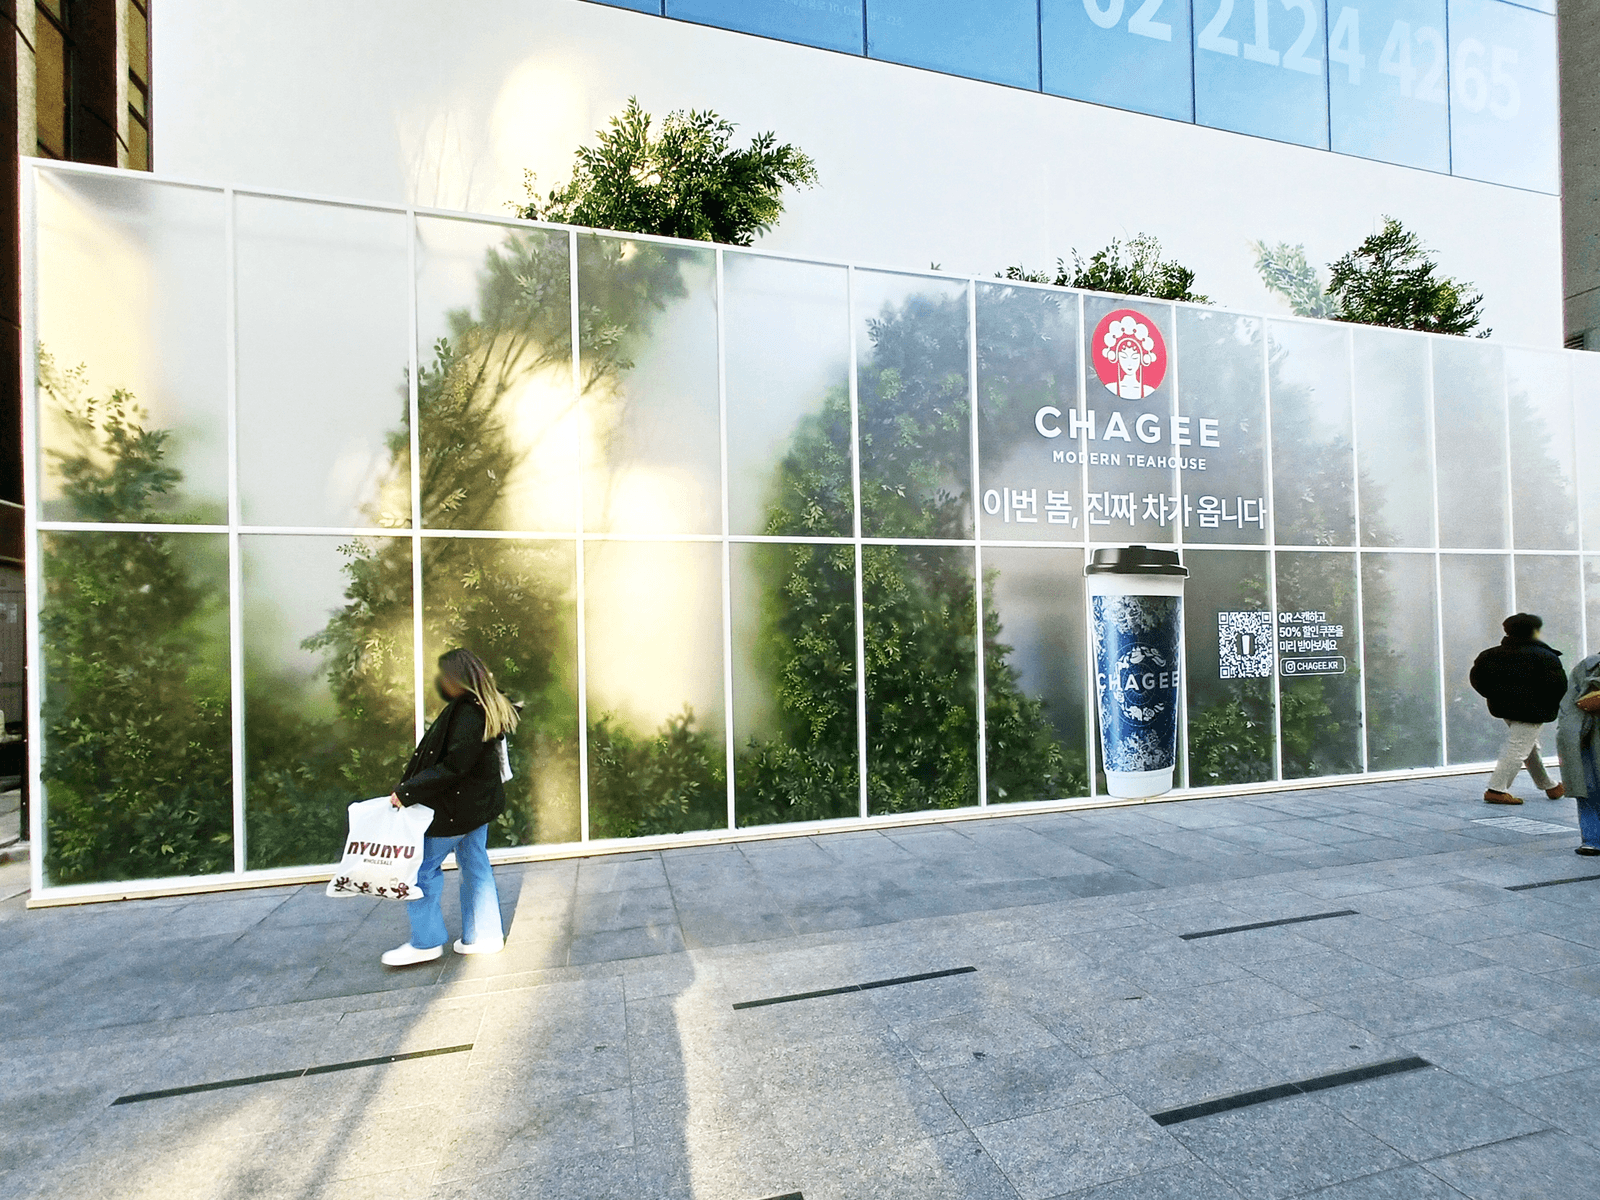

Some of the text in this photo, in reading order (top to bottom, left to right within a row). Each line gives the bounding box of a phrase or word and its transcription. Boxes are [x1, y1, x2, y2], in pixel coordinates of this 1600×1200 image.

[1197, 0, 1366, 86] 2124
[1378, 19, 1521, 120] 4265
[1034, 405, 1221, 448] CHAGEE
[1052, 450, 1207, 470] MODERN TEAHOUSE
[983, 487, 1268, 530] 이번 봄, 진짜 차가 옵니다
[1279, 625, 1343, 637] 50% 할인 쿠폰을
[1279, 640, 1297, 653] 미리
[1297, 661, 1339, 671] CHAGEE.KR
[1097, 671, 1179, 691] CHAGEE
